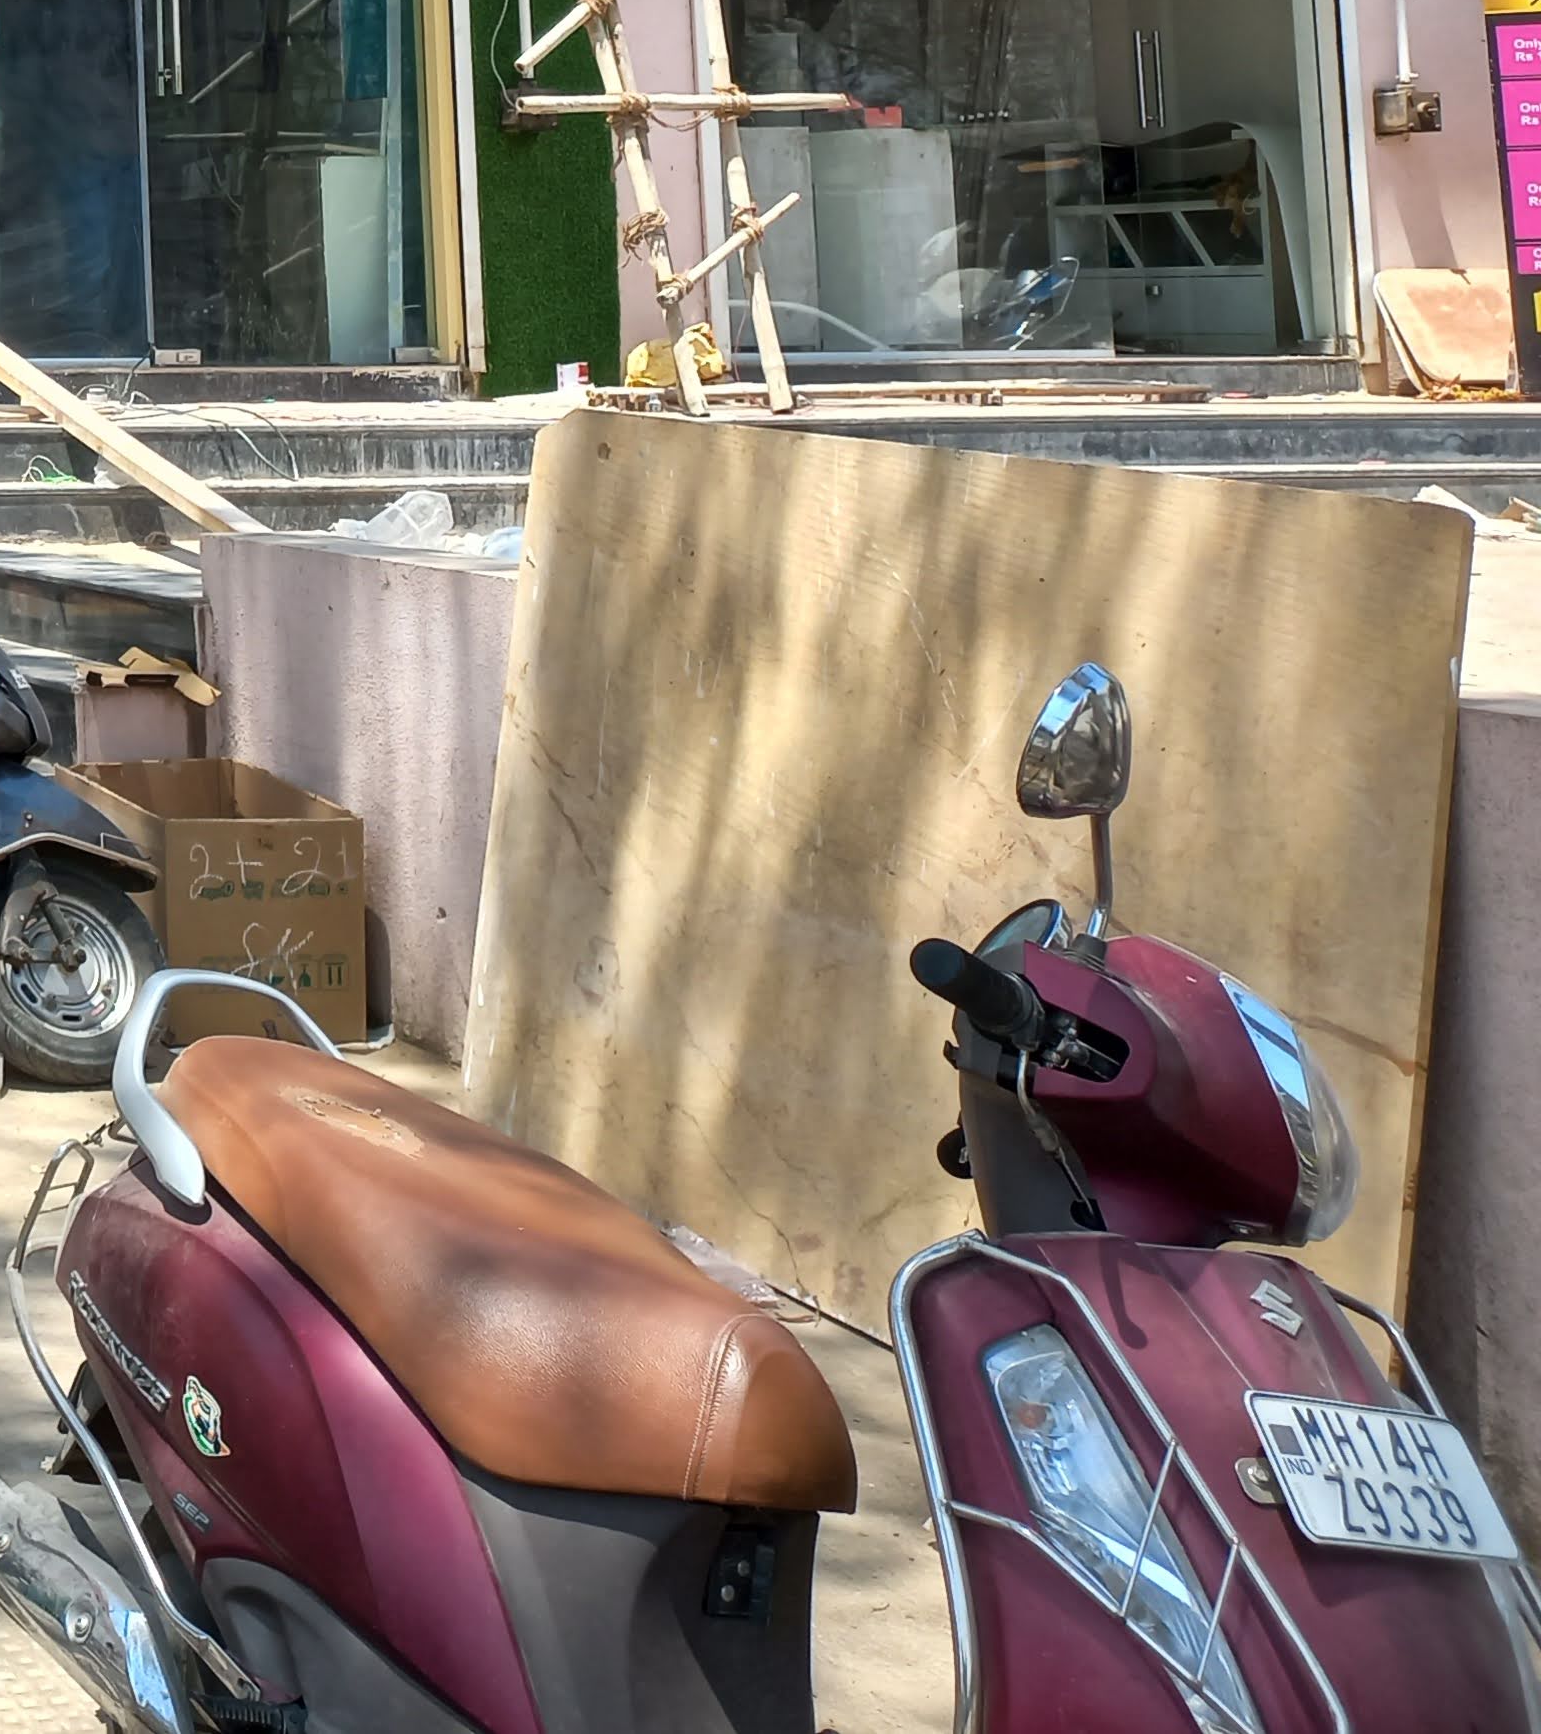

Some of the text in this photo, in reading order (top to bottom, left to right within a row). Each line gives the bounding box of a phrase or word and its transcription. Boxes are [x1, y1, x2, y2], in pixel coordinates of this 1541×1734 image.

[1282, 1457, 1315, 1477] IND
[1291, 1405, 1450, 1481] MH14H
[1323, 1474, 1478, 1549] Z9339
